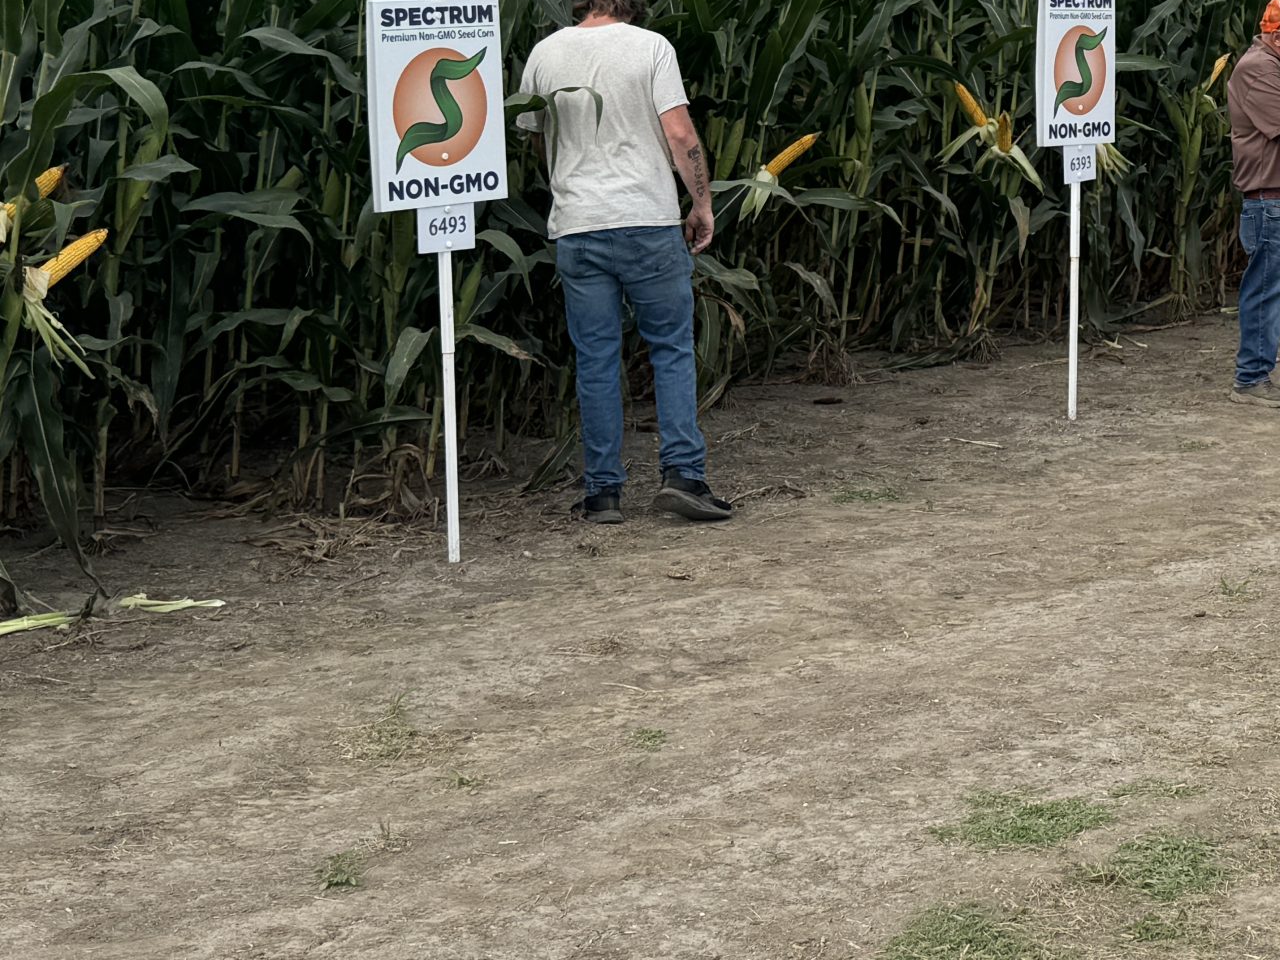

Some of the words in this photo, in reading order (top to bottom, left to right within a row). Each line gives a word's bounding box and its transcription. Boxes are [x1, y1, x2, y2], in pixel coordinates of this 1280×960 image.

[380, 4, 494, 27] SPECTRUM
[381, 33, 417, 43] Premium
[420, 30, 456, 40] Non-GMO
[457, 29, 476, 39] Seed
[477, 28, 494, 38] Corn
[1049, 121, 1111, 139] NON-GMO
[1070, 155, 1091, 171] 6393
[388, 171, 499, 201] NON-GMO
[429, 215, 467, 236] 6493
